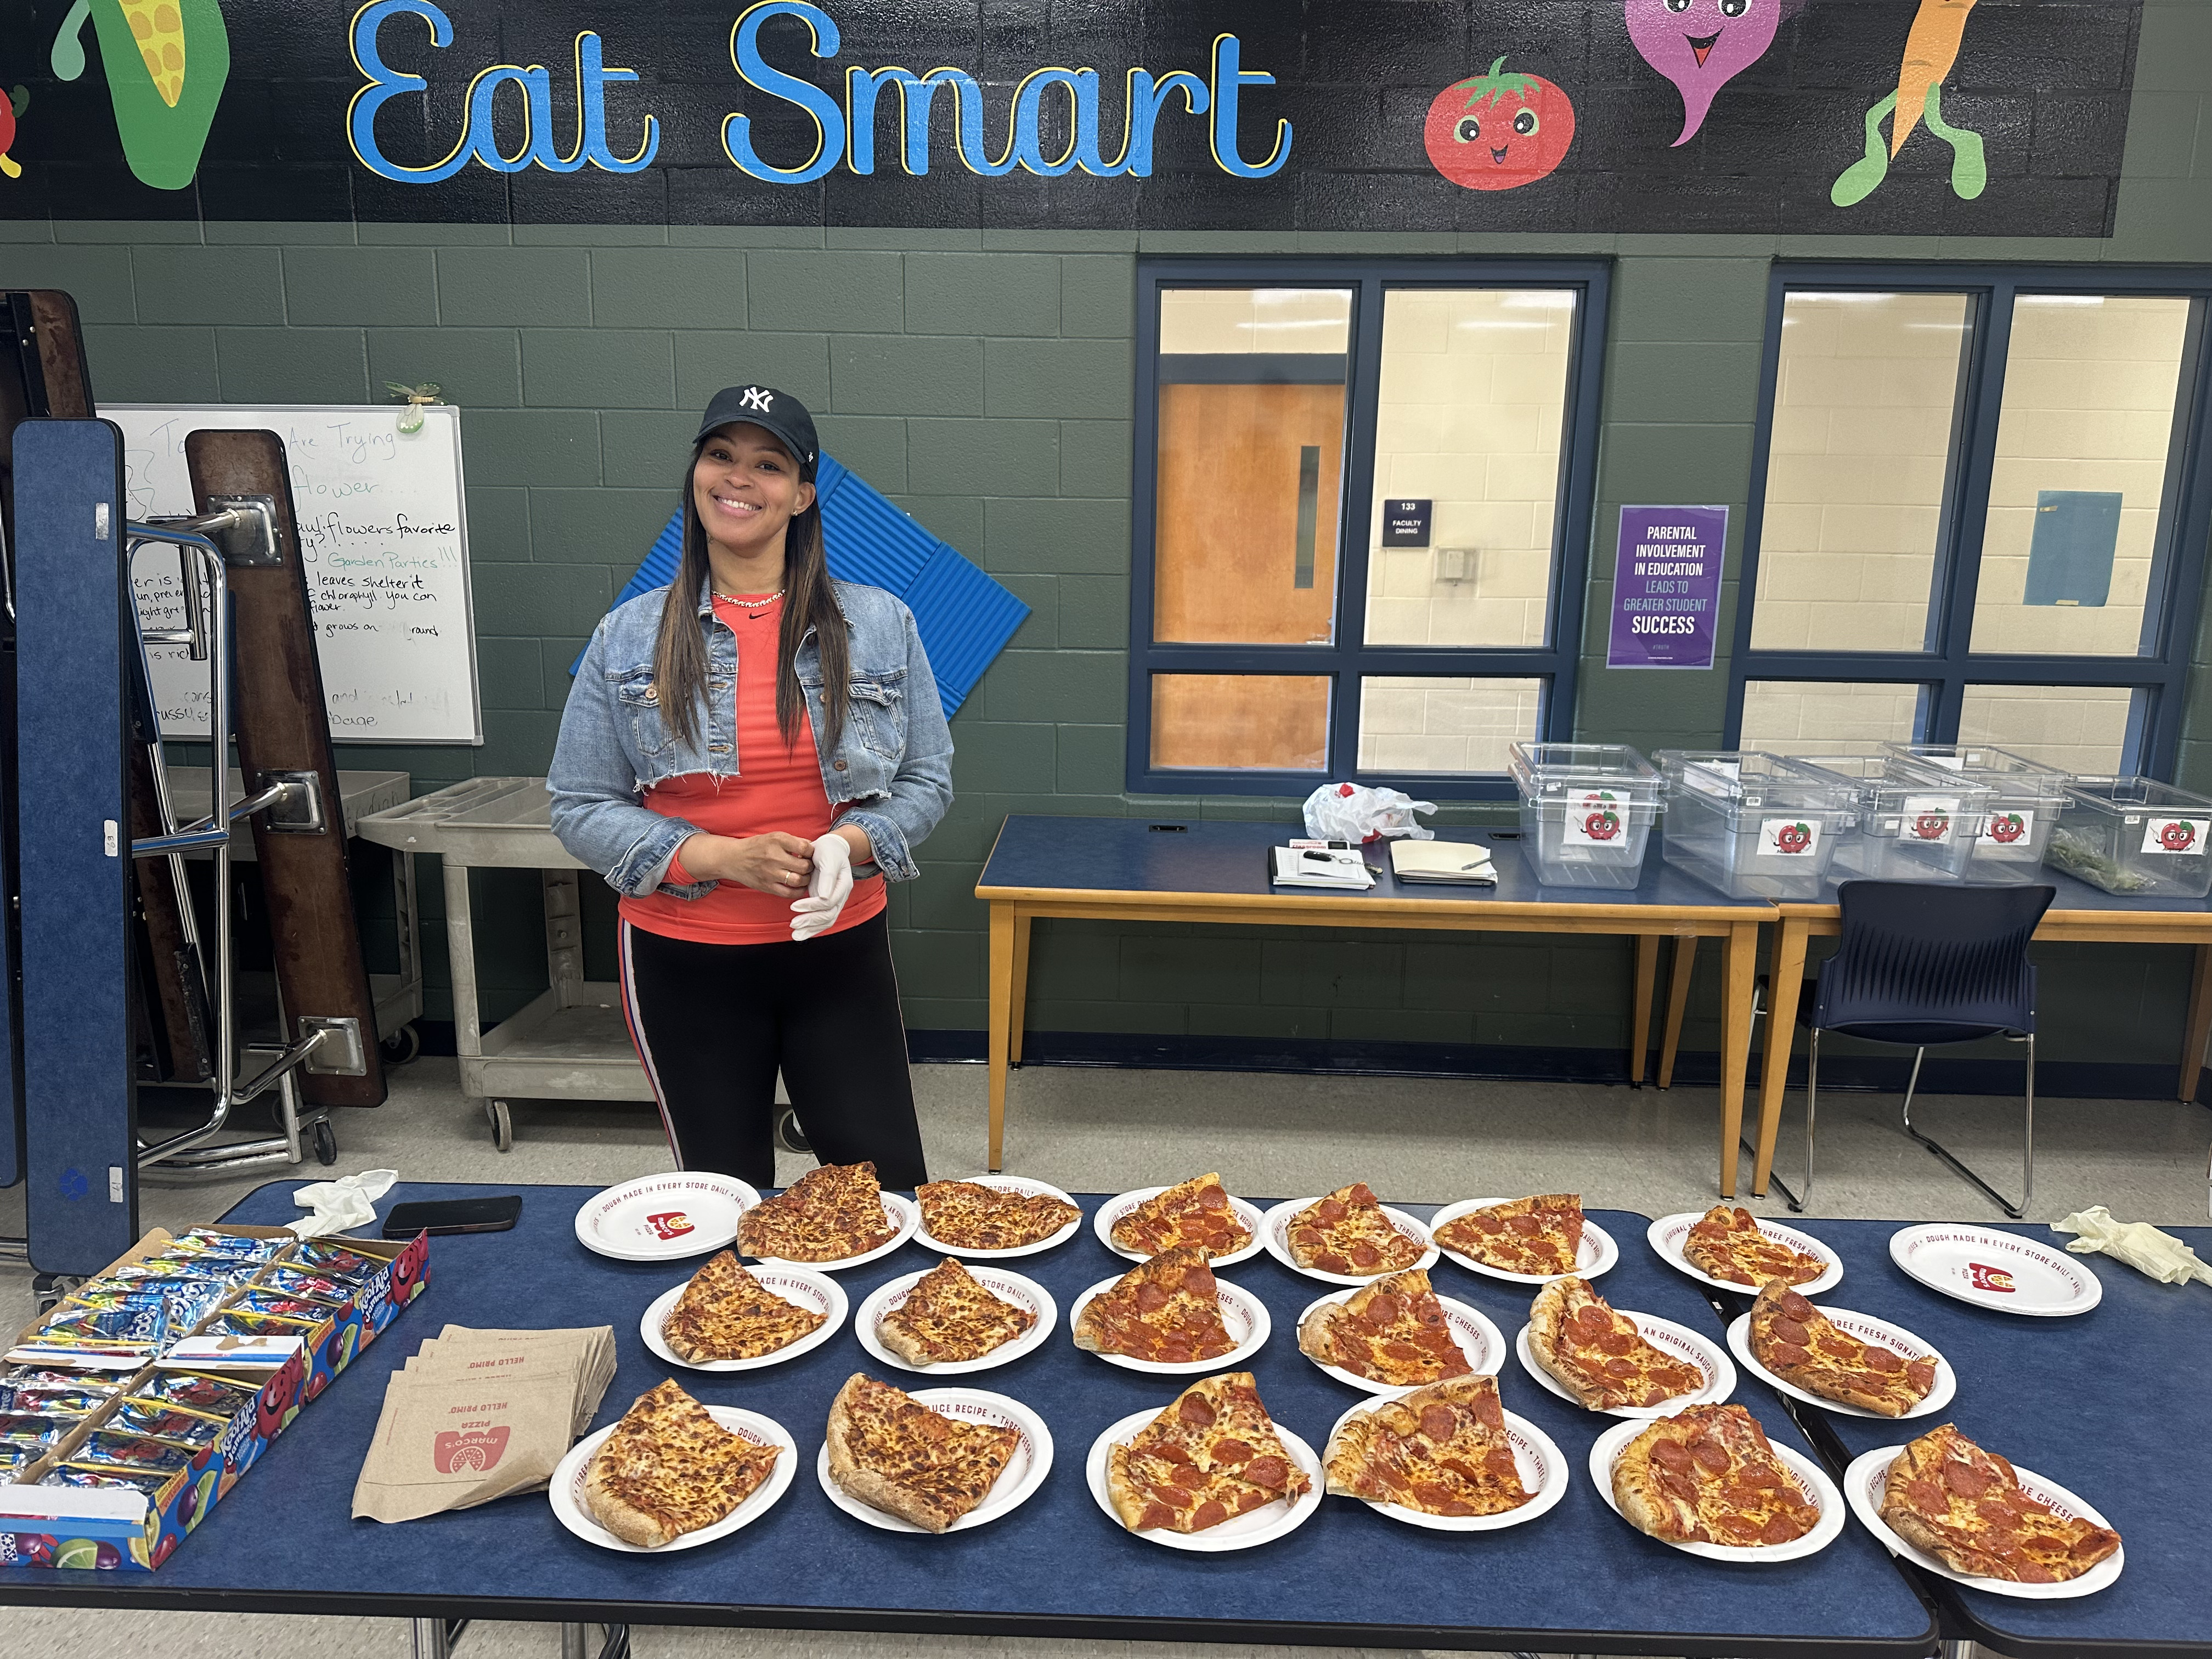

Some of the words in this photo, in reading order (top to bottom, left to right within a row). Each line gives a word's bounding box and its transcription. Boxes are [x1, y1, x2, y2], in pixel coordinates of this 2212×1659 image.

[347, 0, 659, 183] Eat
[721, 0, 1293, 184] Smart
[289, 427, 318, 460] Are
[327, 422, 396, 464] Trying
[397, 514, 455, 539] favorite
[1647, 527, 1697, 539] PARENTAL
[1636, 545, 1706, 557] INVOLVEMENT
[328, 552, 384, 571] Garden
[1634, 562, 1646, 575] IN
[1647, 563, 1703, 575] EDUCATION
[317, 571, 355, 586] leaves
[362, 575, 408, 589] shelter
[410, 574, 424, 589] it
[1645, 580, 1674, 594] LEADS
[1677, 581, 1689, 594] TO
[413, 592, 437, 602] can
[1624, 598, 1663, 611] GREATER
[1666, 599, 1707, 611] STUDENT
[326, 623, 358, 638] grows
[1632, 616, 1695, 634] SUCCESS
[602, 1197, 622, 1212] DOUGH
[623, 1188, 643, 1200] MADE
[657, 1182, 681, 1190] EVERY
[711, 1185, 729, 1195] DAILY
[1120, 1203, 1136, 1216] STORE
[1399, 1224, 1415, 1239] THREE
[1580, 1231, 1595, 1247] SAUCE
[1758, 1228, 1783, 1240] THREE
[1785, 1237, 1806, 1251] FRESH
[1926, 1234, 1950, 1243] DOUGH
[1953, 1234, 1976, 1243] MADE
[1993, 1240, 2021, 1253] EVERY
[2025, 1249, 2050, 1265] STORE
[2051, 1262, 2070, 1278] DAILY
[359, 1266, 389, 1314] Kool-Aid
[790, 1280, 812, 1293] EVERY
[812, 1289, 826, 1305] STORE
[888, 1288, 911, 1305] DOUGH
[981, 1279, 1005, 1290] STORE
[1007, 1286, 1025, 1300] DAILY
[1216, 1291, 1233, 1305] ESES
[365, 1280, 391, 1323] Jammers
[1455, 1316, 1480, 1340] CHEESES
[1830, 1319, 1853, 1330] HREE
[1858, 1325, 1887, 1341] FRESH
[1644, 1327, 1656, 1336] AN
[1659, 1332, 1695, 1355] ORIGINAL
[1695, 1352, 1712, 1373] SAUCE
[498, 1356, 524, 1366] HELLO
[480, 1402, 507, 1412] HELLO
[928, 1404, 950, 1413] UCE
[955, 1404, 988, 1417] RECIPE
[219, 1397, 256, 1458] Kool-Aid
[461, 1419, 490, 1429] PIZZA
[227, 1413, 257, 1466] Jammers
[444, 1436, 498, 1449] MARCO'S
[737, 1427, 761, 1446] DOUGH
[1506, 1430, 1527, 1450] ECIPE
[1533, 1455, 1545, 1478] THREE
[1870, 1470, 1886, 1491] RECIPE
[2037, 1493, 2073, 1522] CHEESE
